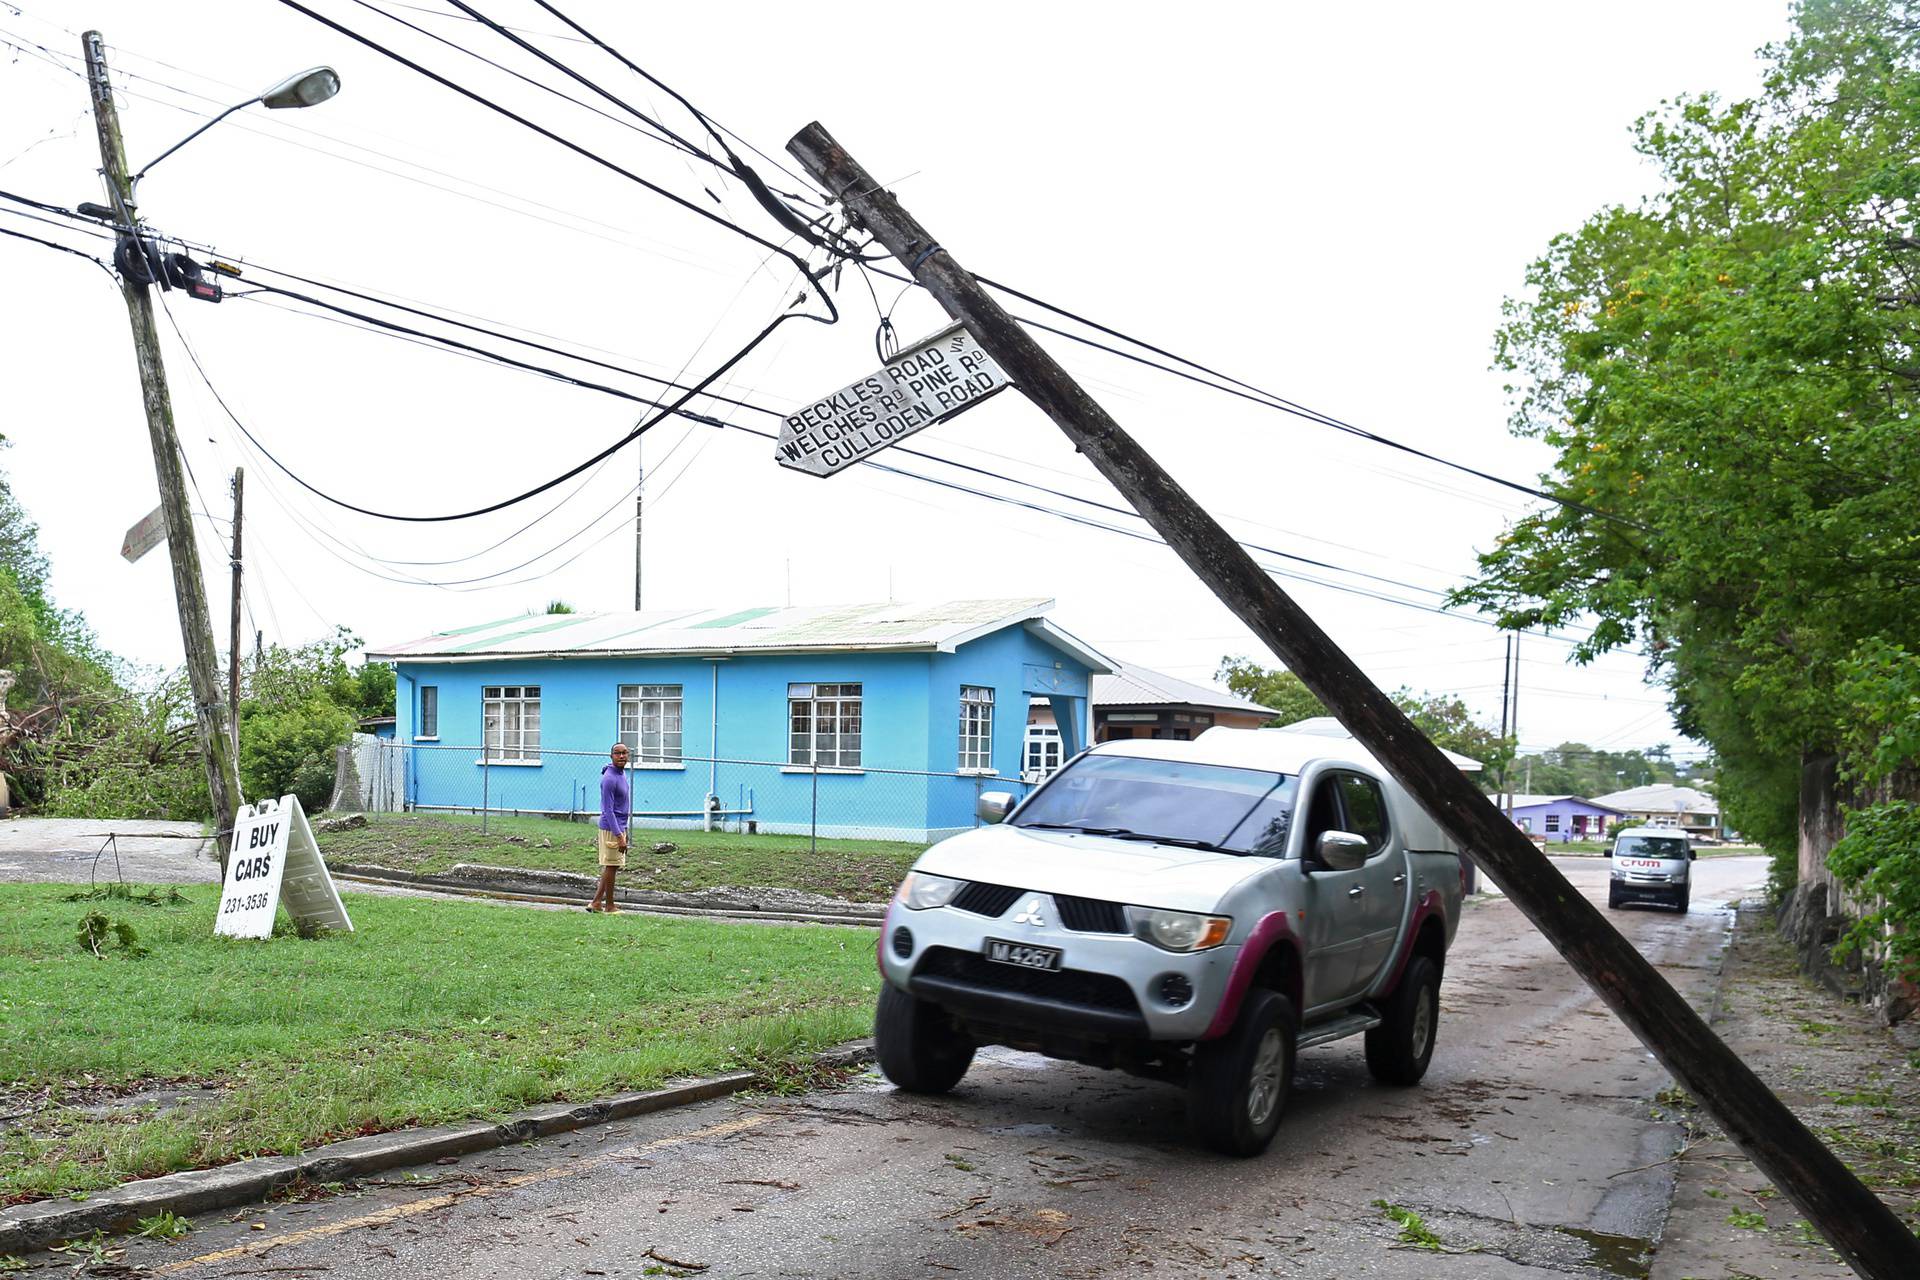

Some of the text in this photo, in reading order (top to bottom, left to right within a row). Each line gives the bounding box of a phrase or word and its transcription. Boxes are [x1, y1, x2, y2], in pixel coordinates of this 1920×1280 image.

[950, 336, 965, 353] VIA
[787, 347, 944, 435] BECKLES ROAD
[780, 405, 877, 462] WELCHES
[909, 364, 959, 398] PINE
[821, 372, 995, 467] CULLODEN ROAD
[234, 822, 280, 852] I BUY
[235, 855, 271, 882] CARS
[224, 892, 269, 914] 231-3536
